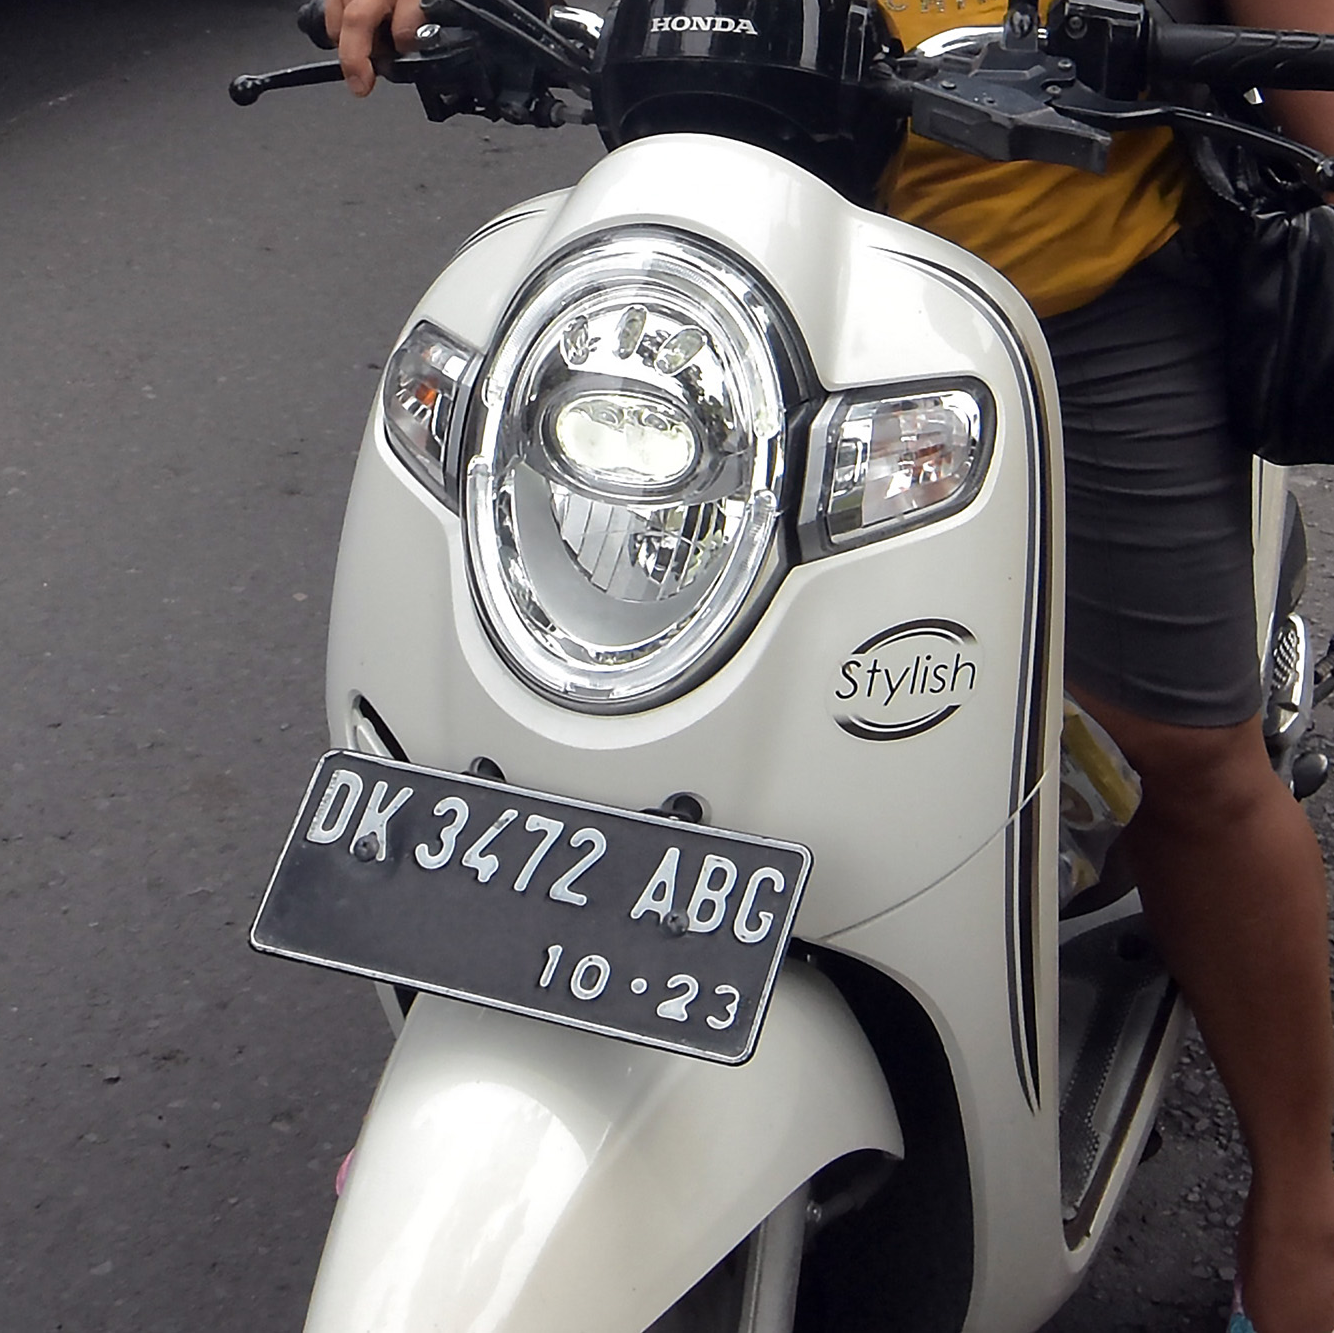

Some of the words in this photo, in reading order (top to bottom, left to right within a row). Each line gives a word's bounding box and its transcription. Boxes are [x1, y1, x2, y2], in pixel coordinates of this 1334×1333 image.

[650, 16, 758, 35] HONDA
[835, 652, 977, 706] Stylish
[306, 768, 413, 862] DK
[414, 796, 607, 906] 3472
